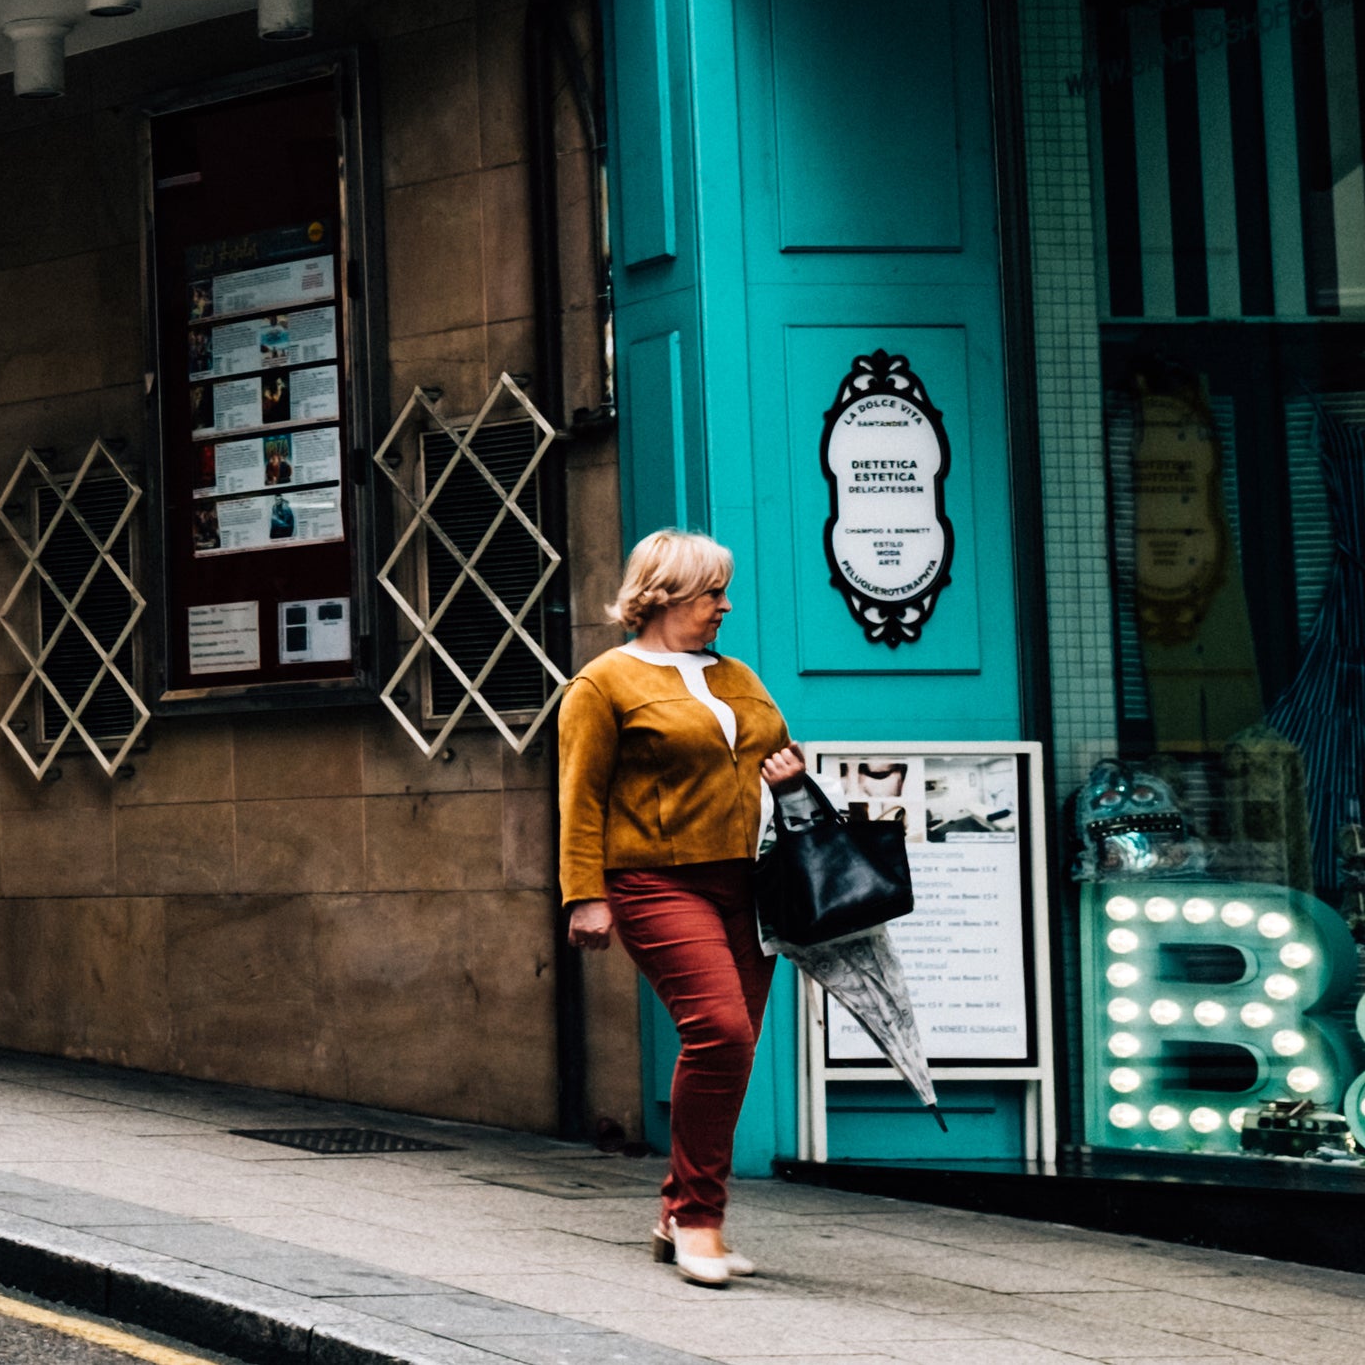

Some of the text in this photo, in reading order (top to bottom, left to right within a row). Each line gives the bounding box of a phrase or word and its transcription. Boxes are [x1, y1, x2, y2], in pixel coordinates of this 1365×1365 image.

[844, 399, 923, 425] LA DOLCE VITA
[855, 473, 916, 482] ESTETICA
[848, 486, 924, 494] DELICATESSEN
